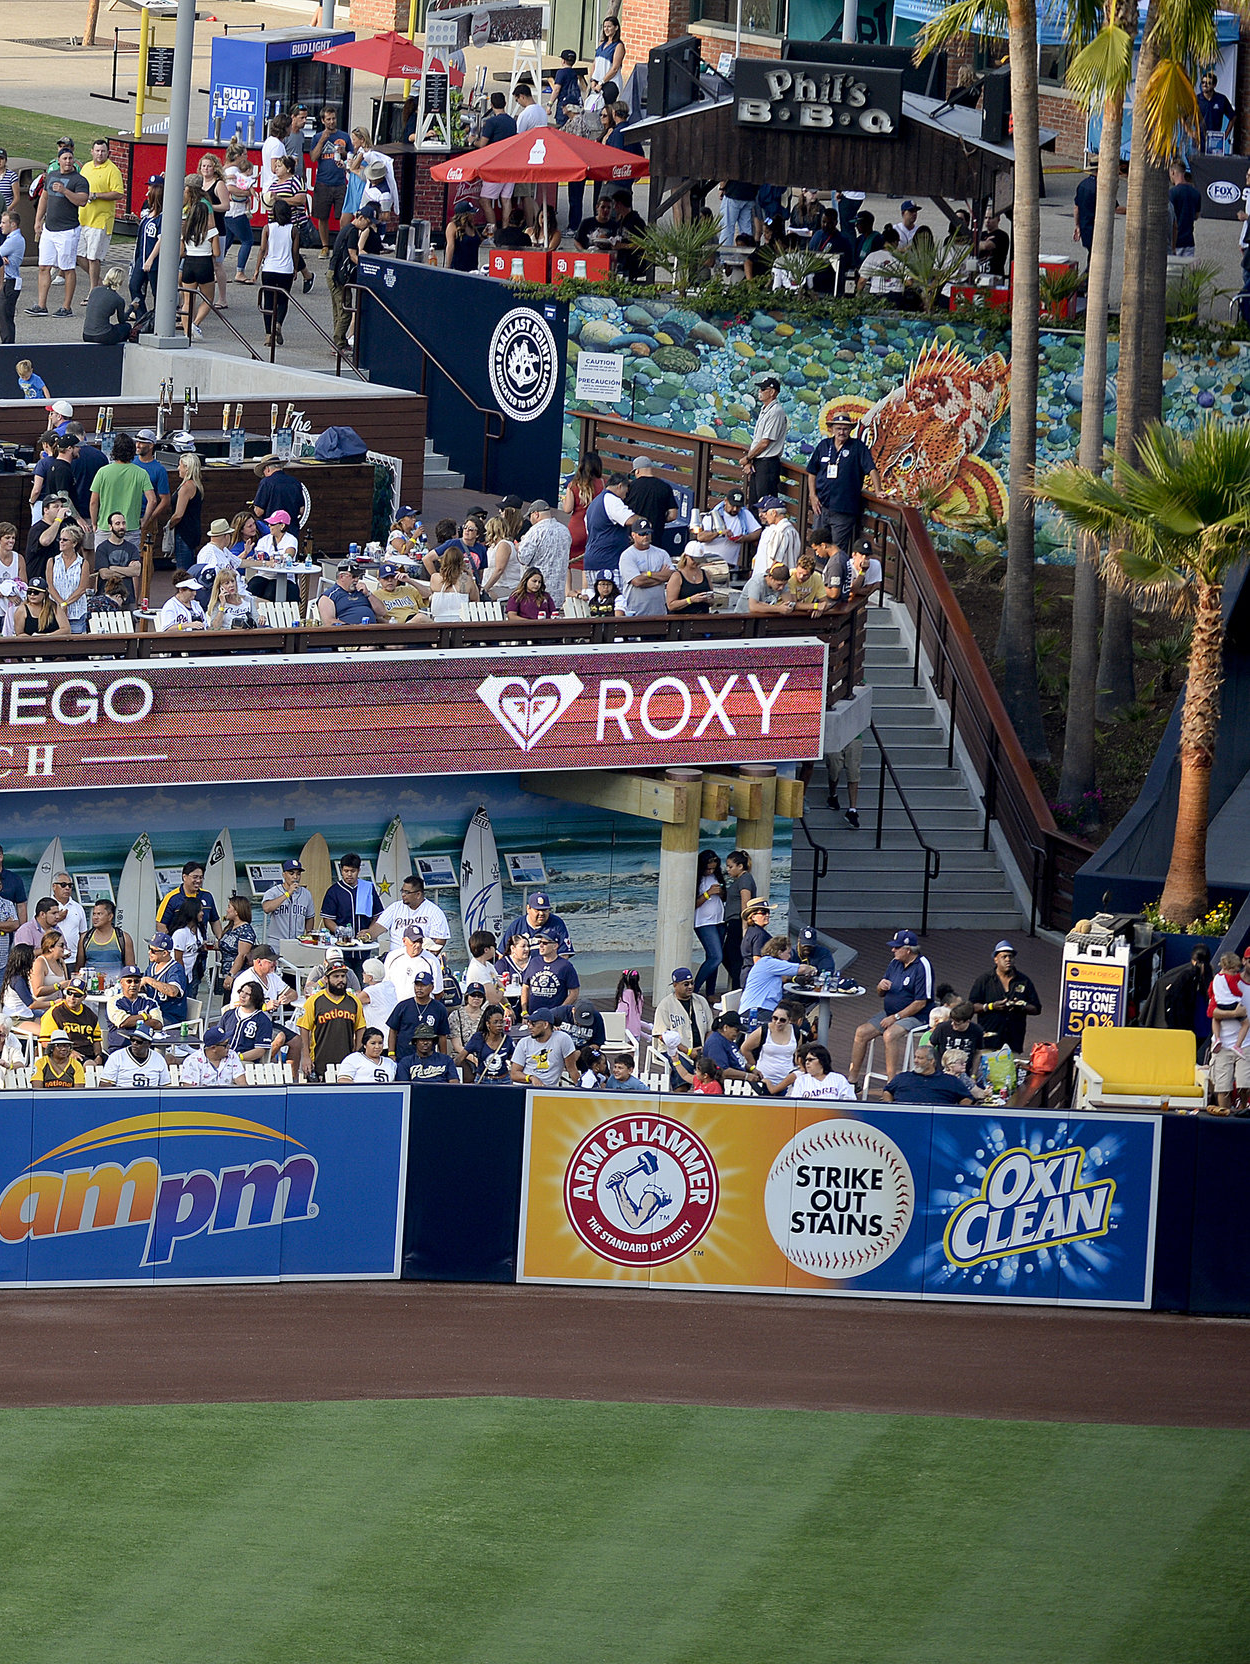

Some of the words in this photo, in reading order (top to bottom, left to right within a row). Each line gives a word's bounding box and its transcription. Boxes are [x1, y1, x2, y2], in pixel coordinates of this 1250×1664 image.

[292, 43, 309, 56] BUD
[309, 39, 333, 53] LIGHT
[764, 69, 867, 107] Phil's
[1214, 185, 1233, 196] FOX
[496, 318, 532, 354] BALLAST
[531, 324, 551, 365] POINT
[585, 358, 616, 366] CAUTION
[496, 364, 518, 407] DEDICATED
[517, 401, 526, 409] TO
[525, 396, 538, 408] THE
[536, 371, 551, 402] CRAFT
[577, 377, 621, 386] PRECAUCIÓN
[290, 411, 312, 432] The
[596, 672, 791, 741] ROXY
[473, 817, 489, 829] REEF
[274, 904, 289, 916] SAN
[394, 916, 429, 930] PADRES
[1068, 999, 1091, 1011] GET
[1091, 1002, 1116, 1014] ONE
[1069, 989, 1093, 1001] BUY
[1092, 991, 1117, 1004] ONE
[669, 1013, 686, 1029] SAN
[1067, 1011, 1114, 1033] 50%
[409, 1063, 447, 1081] Padres
[803, 1086, 839, 1099] PADRES
[573, 1141, 609, 1202] ARM
[604, 1128, 628, 1150] &
[629, 1121, 710, 1206] HAMMER
[795, 1165, 883, 1191] STRIKE
[987, 1151, 1081, 1210] OXI
[810, 1191, 866, 1214] OUT
[790, 1212, 883, 1238] STAINS
[950, 1186, 1110, 1260] CLEAN
[587, 1216, 601, 1235] THE
[599, 1230, 649, 1254] STANDARD
[650, 1240, 663, 1252] OF
[663, 1219, 693, 1248] PURITY
